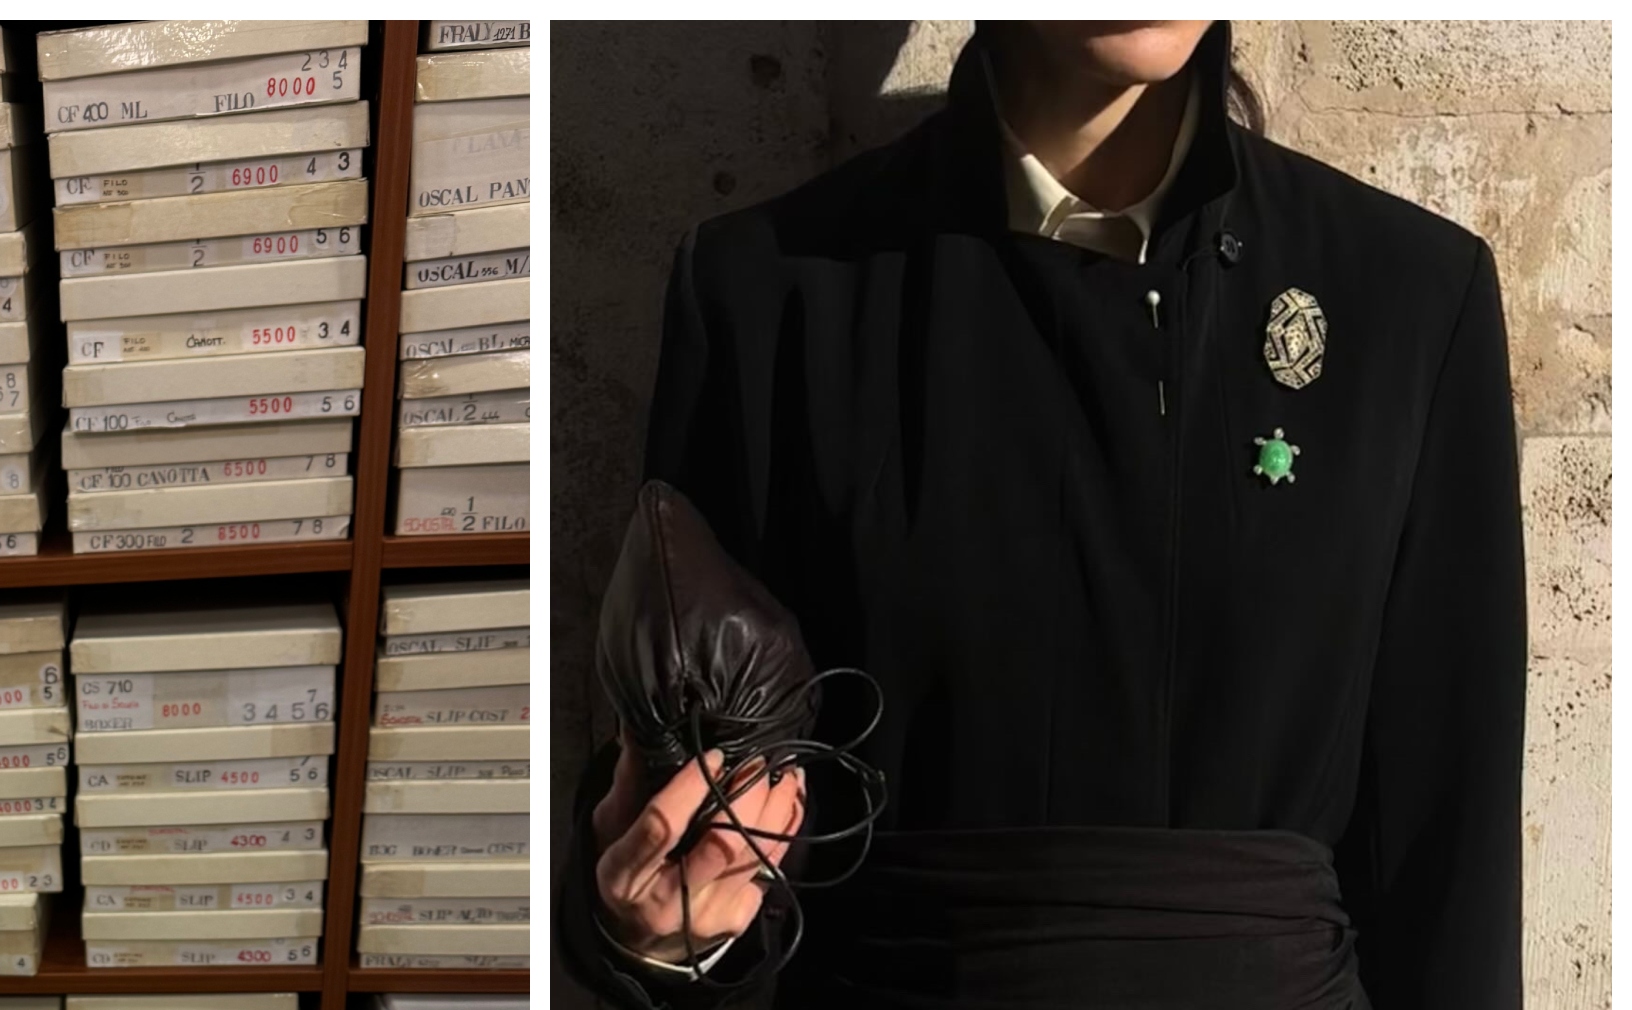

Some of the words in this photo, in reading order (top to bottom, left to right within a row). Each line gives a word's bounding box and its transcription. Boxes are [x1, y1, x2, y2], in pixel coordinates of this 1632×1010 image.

[438, 22, 495, 43] FRALY
[121, 102, 148, 120] ML
[213, 92, 256, 113] FILO
[267, 77, 315, 98] 8000
[332, 71, 343, 89] 5
[66, 178, 91, 195] CF
[232, 164, 279, 186] 6900
[306, 157, 316, 175] 4
[337, 152, 350, 171] 3
[419, 186, 478, 208] OSCAL
[71, 250, 95, 268] CF
[253, 235, 299, 253] 6900
[316, 228, 327, 245] 5
[339, 227, 350, 244] 6
[2, 297, 12, 313] 4
[251, 326, 296, 345] 5500
[318, 322, 329, 338] 3
[340, 319, 350, 336] 4
[6, 373, 17, 389] 8
[104, 414, 129, 430] 100
[248, 396, 293, 415] 5500
[107, 473, 132, 488] 100
[137, 467, 211, 487] CANOTTA
[223, 459, 267, 477] 6500
[482, 516, 526, 530] FILO
[90, 535, 113, 550] CF
[116, 534, 146, 549] 300
[217, 523, 261, 541] 8500
[455, 636, 495, 649] SLIP
[82, 682, 100, 695] CS
[107, 680, 134, 695] 710
[162, 703, 202, 718] 8000
[88, 775, 109, 787] CA
[175, 770, 212, 784] SLIP
[221, 771, 260, 784] 4500
[173, 840, 208, 851] SLIP
[179, 895, 214, 906] SLIP
[237, 893, 273, 905] 4500
[180, 952, 216, 963] SLIP
